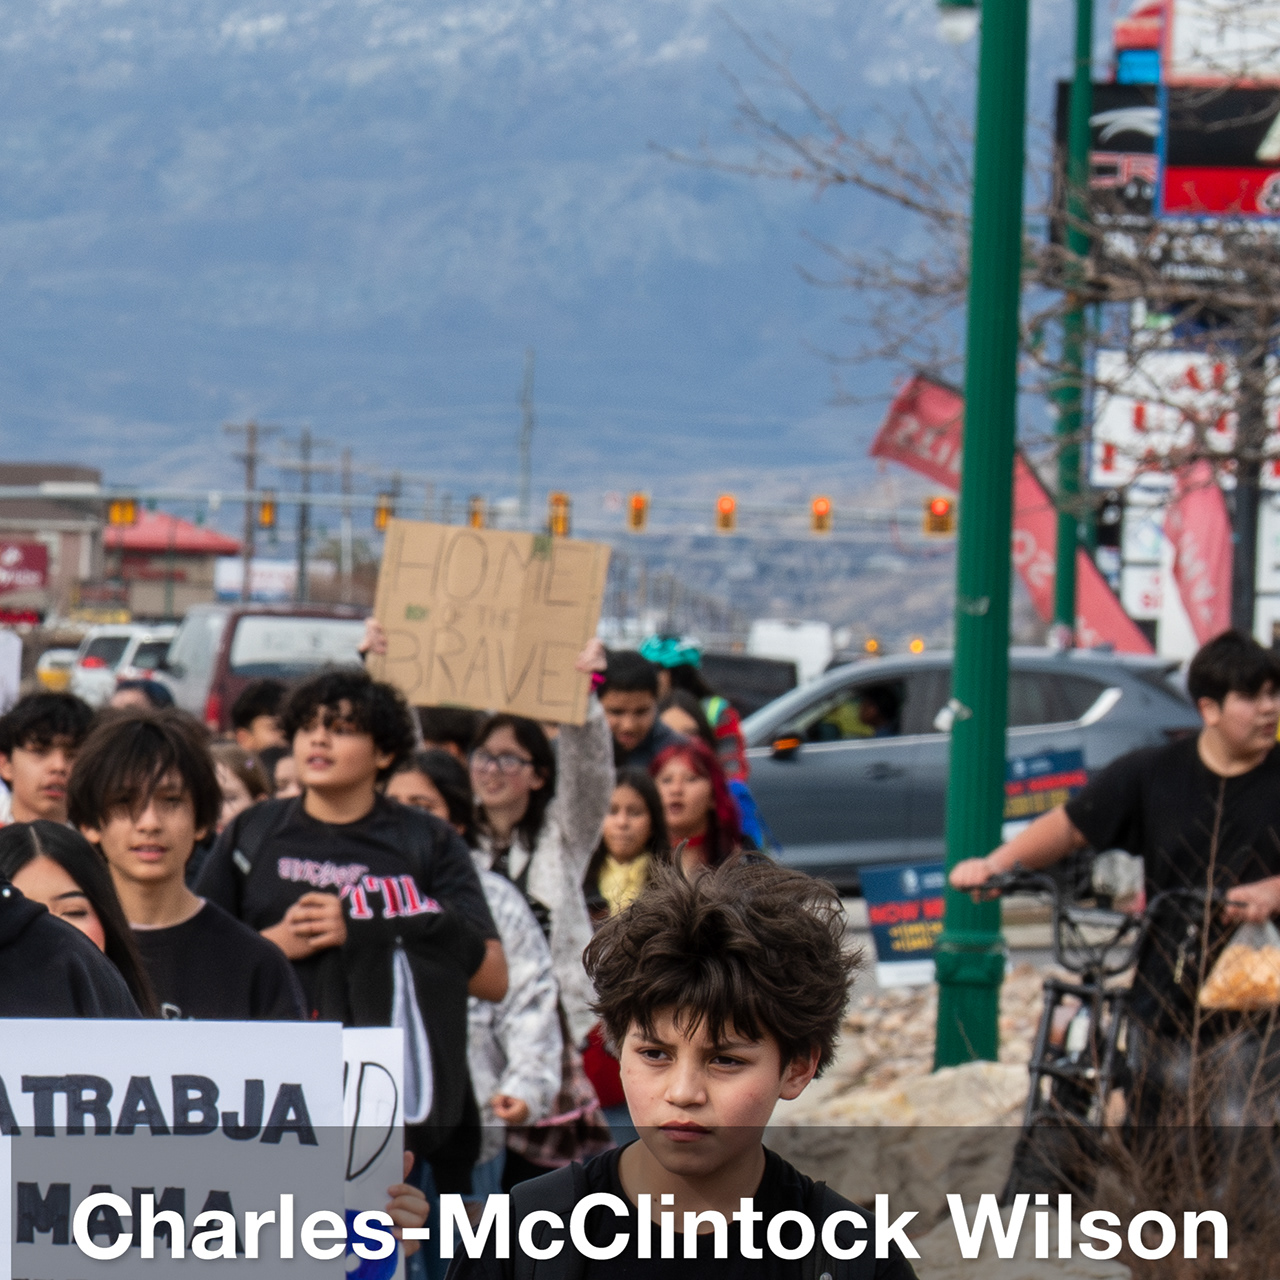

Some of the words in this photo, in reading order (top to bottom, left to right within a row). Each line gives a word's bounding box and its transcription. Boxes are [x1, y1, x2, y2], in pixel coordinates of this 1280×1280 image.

[392, 527, 588, 608] HOME
[381, 626, 580, 707] BRAVE
[15, 1180, 246, 1255] MAMA
